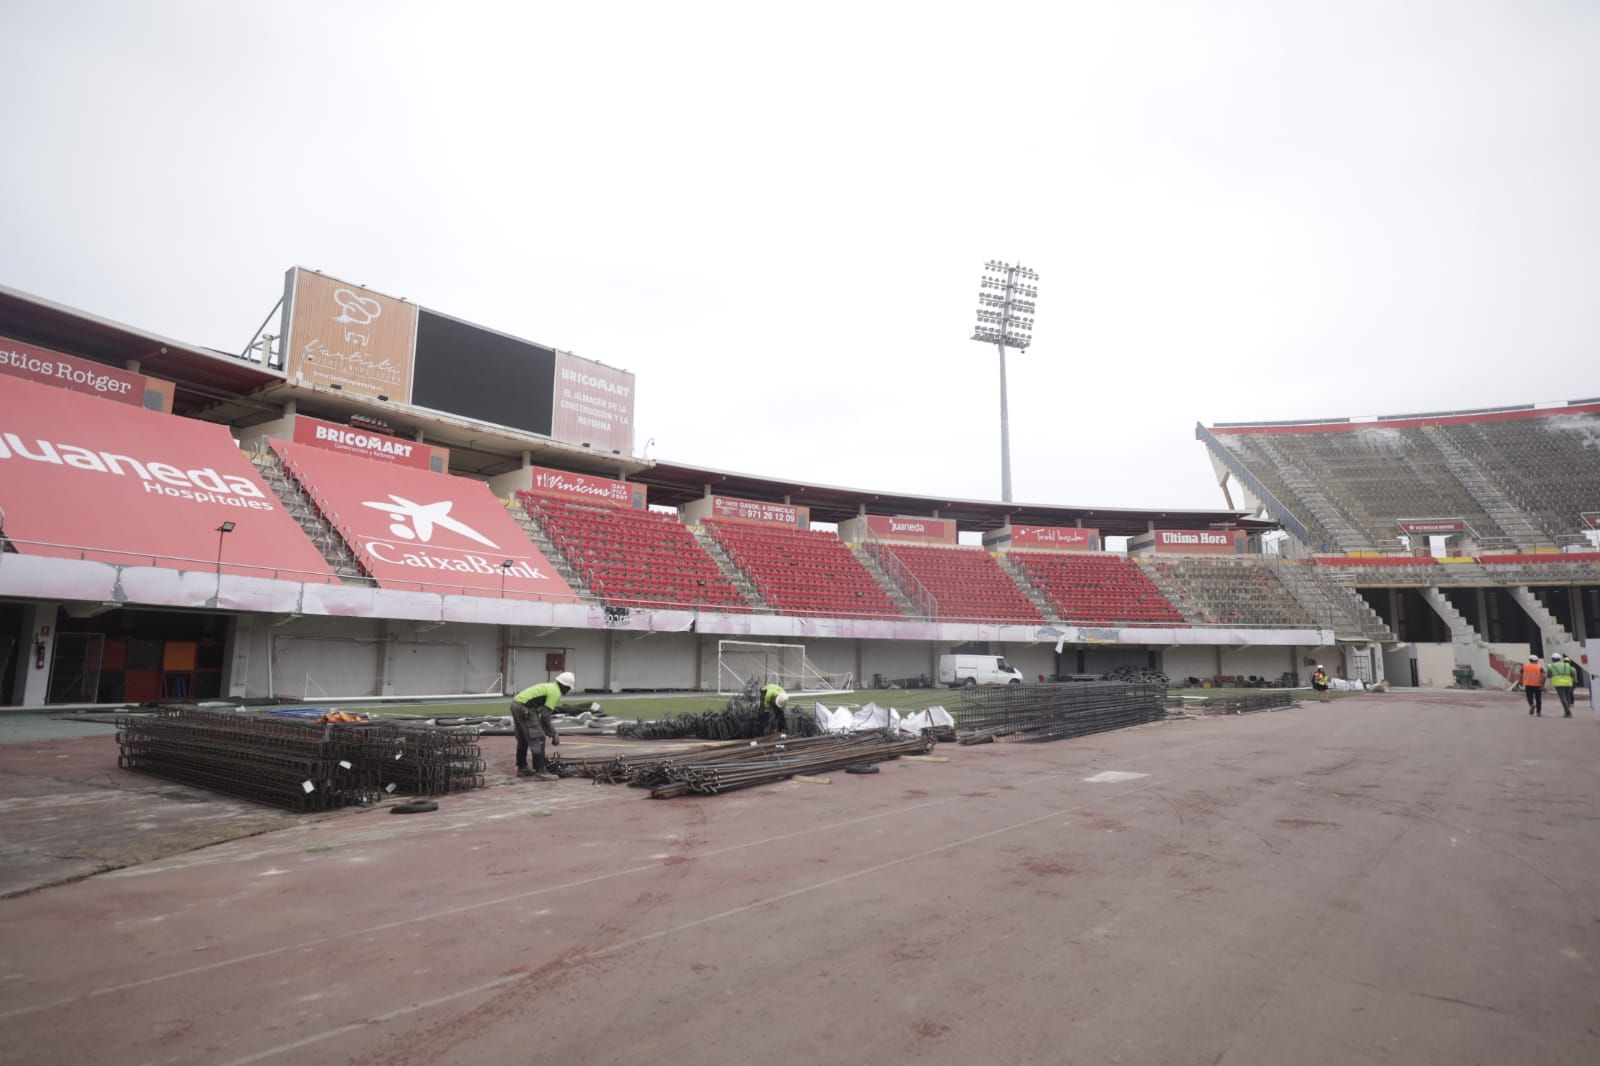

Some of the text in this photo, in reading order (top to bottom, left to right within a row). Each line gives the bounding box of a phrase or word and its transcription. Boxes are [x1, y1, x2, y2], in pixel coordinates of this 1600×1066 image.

[55, 361, 132, 394] Rotger
[315, 425, 413, 458] BRICOMART
[143, 481, 274, 511] Hospitales
[547, 474, 611, 497] Vinicius
[747, 510, 761, 519] 971
[785, 514, 795, 522] 09
[892, 523, 925, 533] juaneda
[1161, 532, 1227, 545] Ultima Hora
[364, 541, 551, 580] CaixaBank
